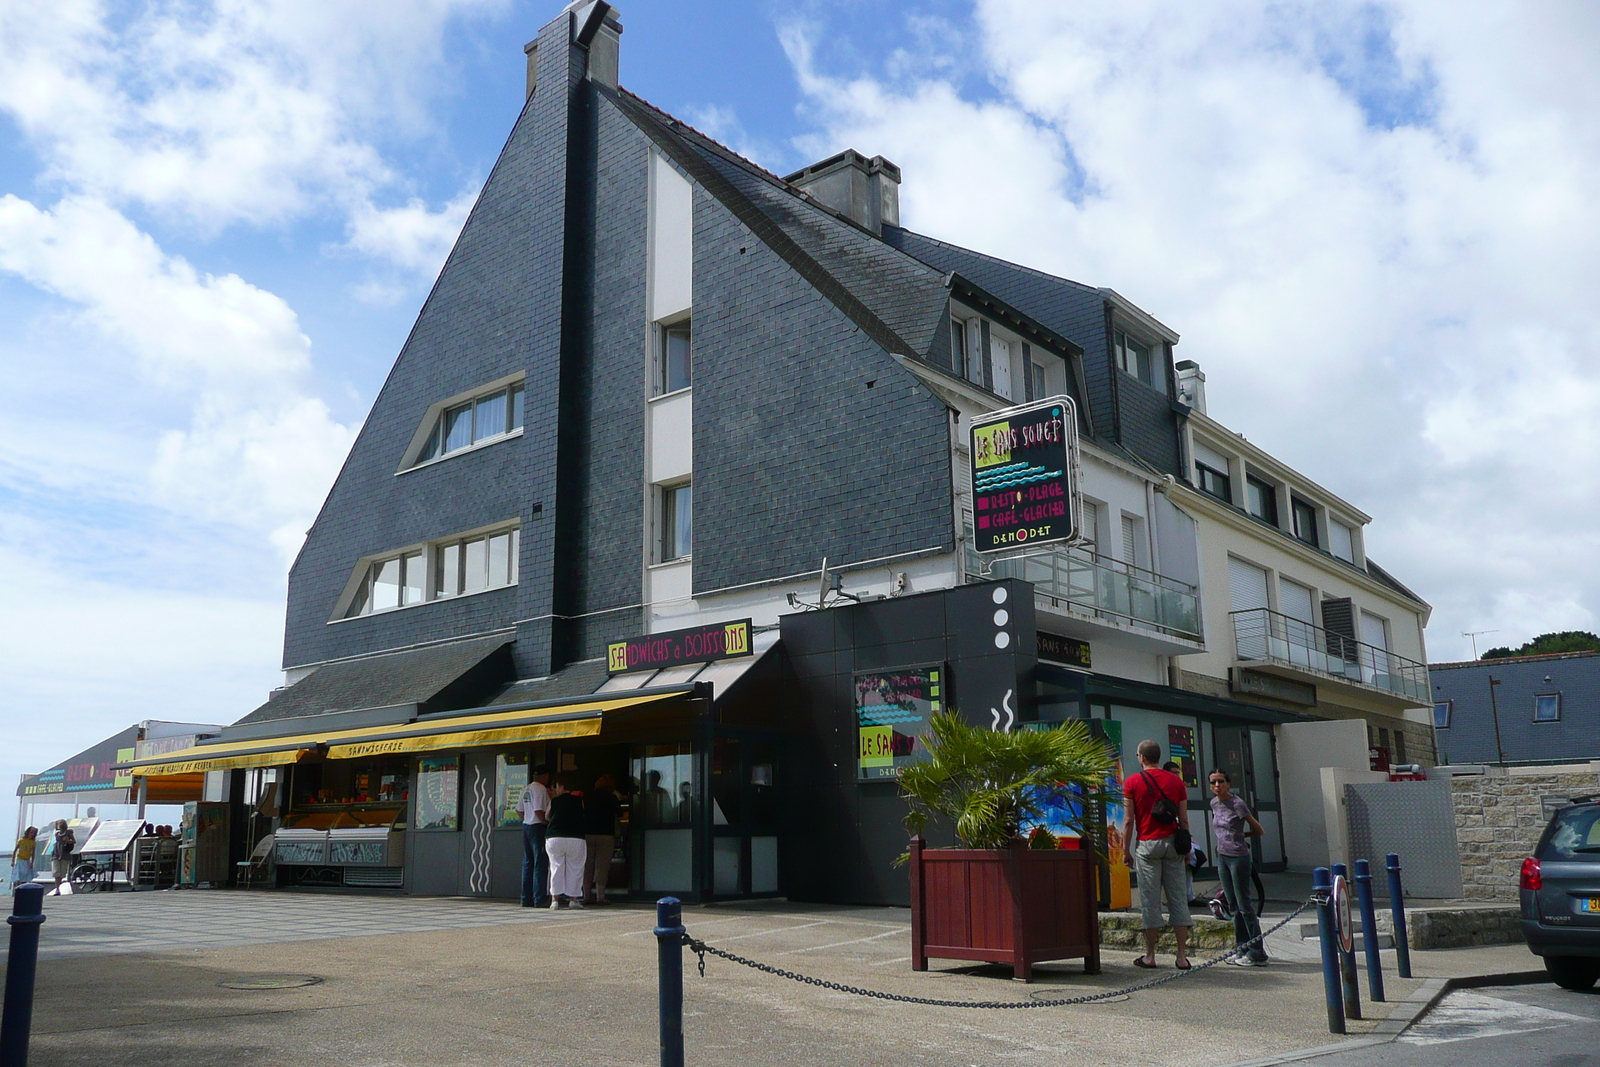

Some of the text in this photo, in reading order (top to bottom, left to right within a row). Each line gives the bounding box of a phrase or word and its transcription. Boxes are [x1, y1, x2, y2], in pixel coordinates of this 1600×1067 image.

[992, 428, 1018, 456] SANS
[611, 637, 673, 669] SANDWICHS
[685, 627, 745, 657] BOISSONS
[862, 735, 873, 757] LE
[876, 734, 901, 756] SANS
